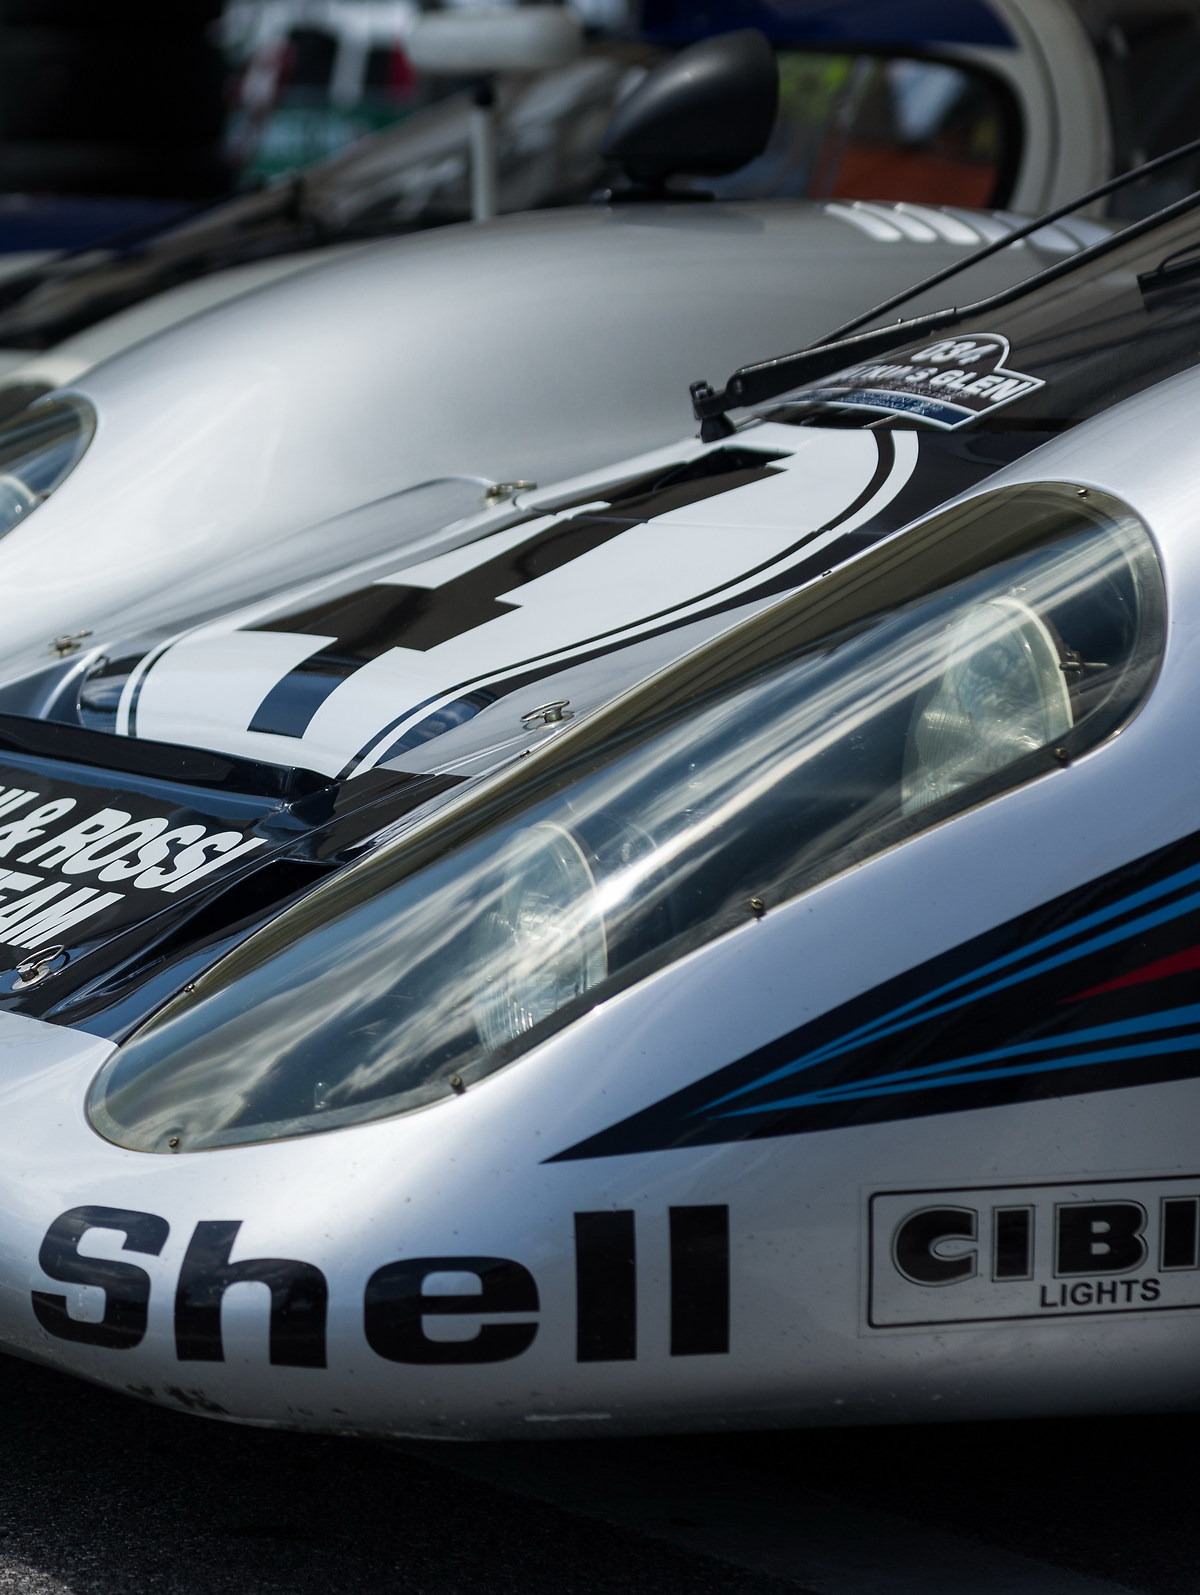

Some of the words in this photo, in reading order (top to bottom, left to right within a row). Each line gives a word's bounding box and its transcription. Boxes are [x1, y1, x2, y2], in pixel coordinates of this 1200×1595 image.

[930, 368, 1035, 403] GLEN
[15, 806, 270, 894] ROSSI
[31, 1203, 731, 1369] Shell
[1039, 1278, 1161, 1308] LIGHTS
